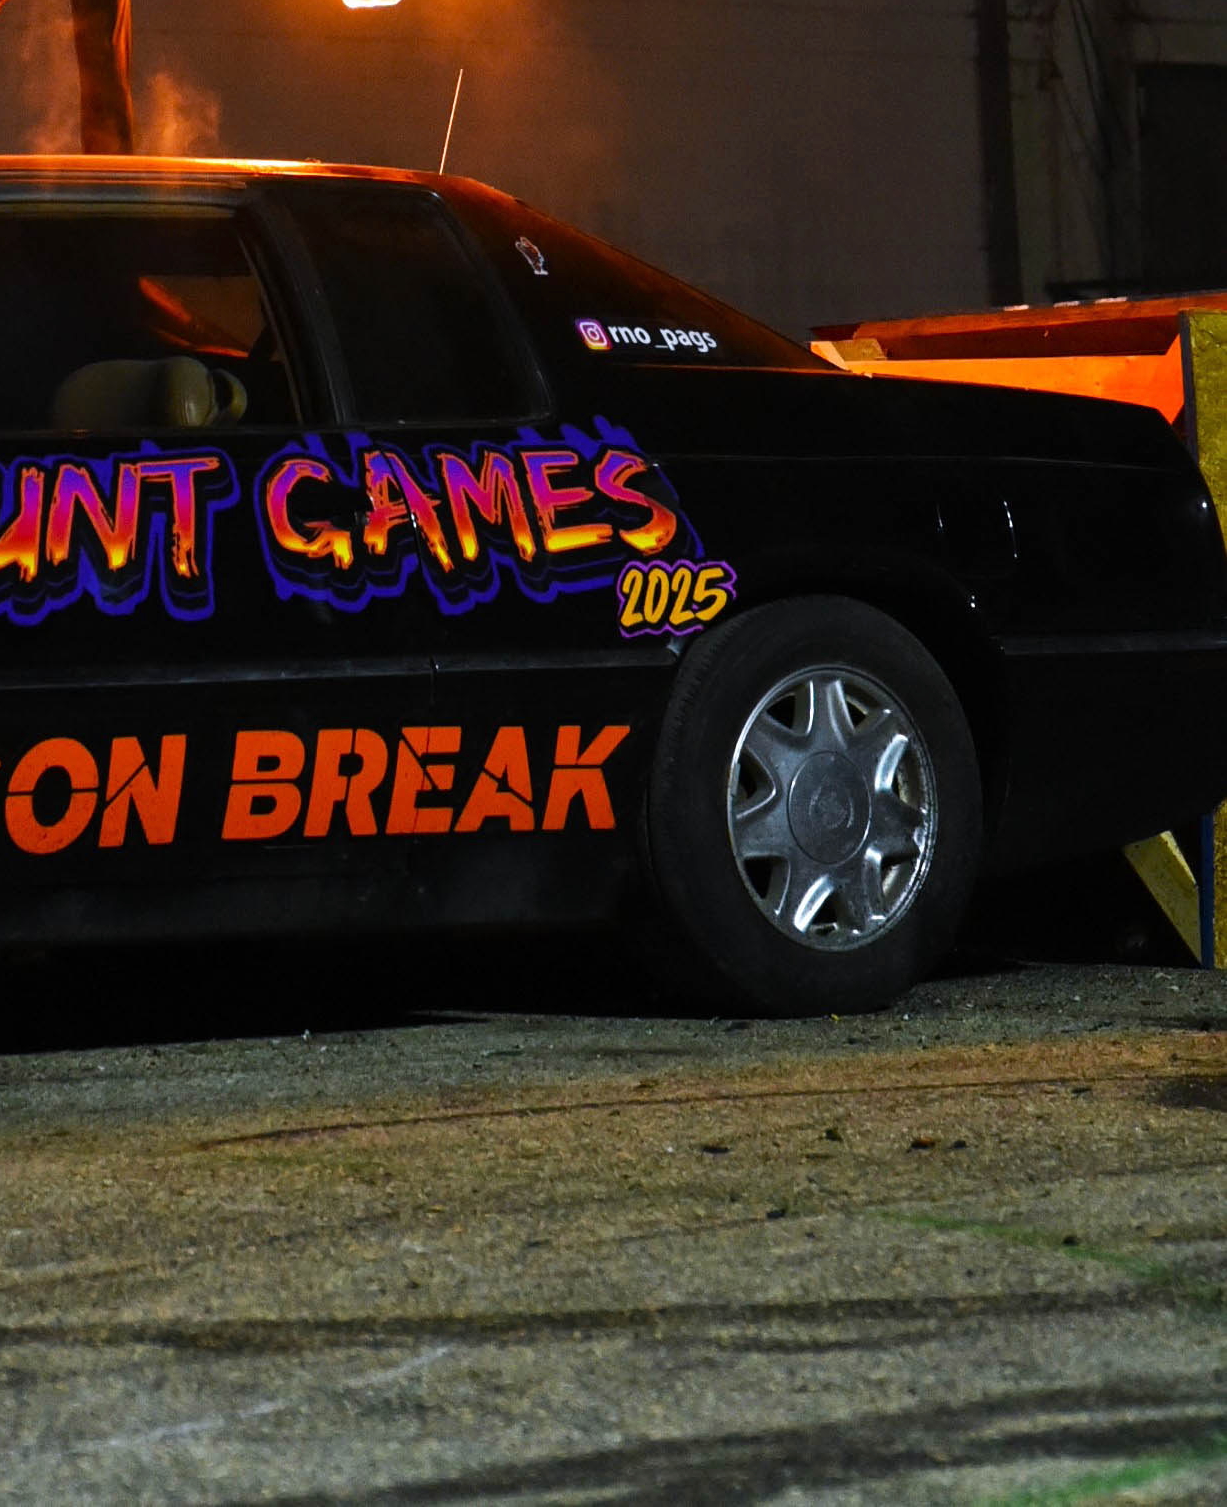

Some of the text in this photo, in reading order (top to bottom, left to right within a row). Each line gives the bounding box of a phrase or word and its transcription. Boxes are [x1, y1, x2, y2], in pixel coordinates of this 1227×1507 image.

[265, 448, 678, 573] GAMES
[619, 566, 729, 628] 2025
[221, 724, 631, 841] BREAK
